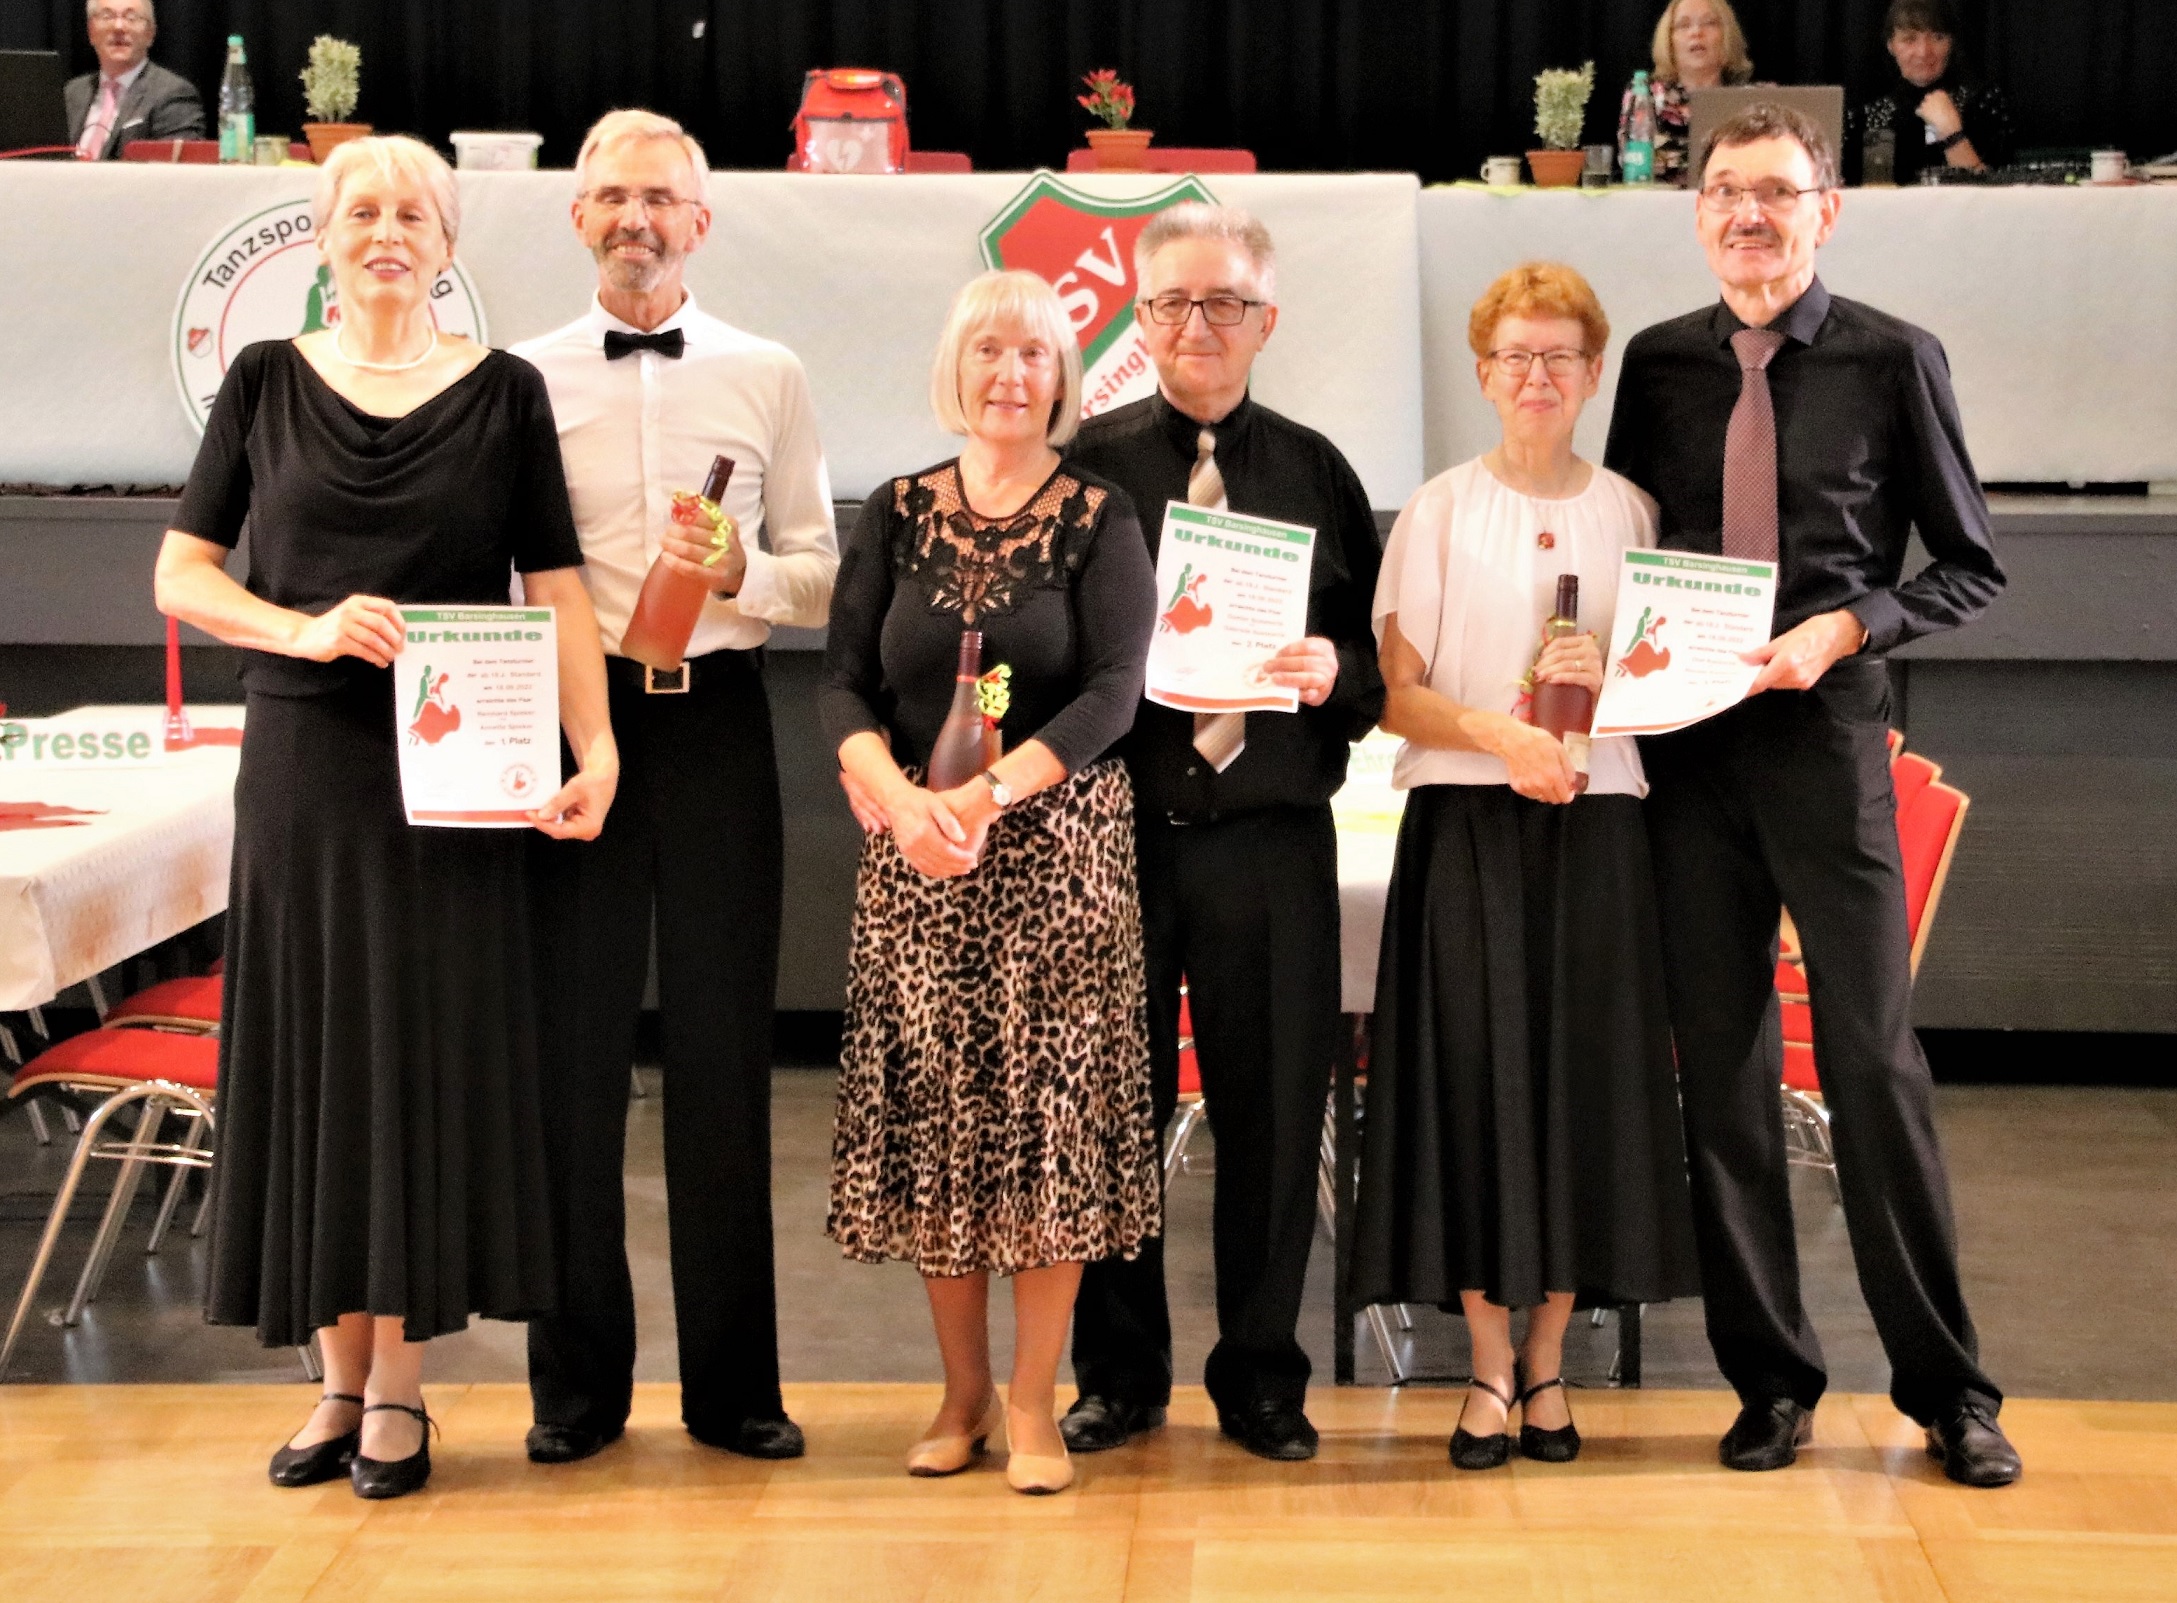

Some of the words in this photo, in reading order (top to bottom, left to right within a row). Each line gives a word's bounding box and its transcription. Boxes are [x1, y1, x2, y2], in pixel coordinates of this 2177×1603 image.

[203, 213, 312, 291] Tanzspo
[1053, 226, 1127, 334] SV
[1206, 515, 1223, 527] TSV
[1224, 519, 1288, 540] Barsinghausen
[1174, 528, 1300, 562] Urkunde
[1663, 556, 1681, 567] TSV
[1682, 560, 1748, 574] Barsinghausen
[1632, 571, 1762, 597] Urkunde
[437, 611, 455, 621] TSV
[457, 611, 526, 621] Barsinghausen
[407, 630, 543, 643] Urkunde
[2, 722, 151, 761] Presse
[509, 737, 531, 745] Platz
